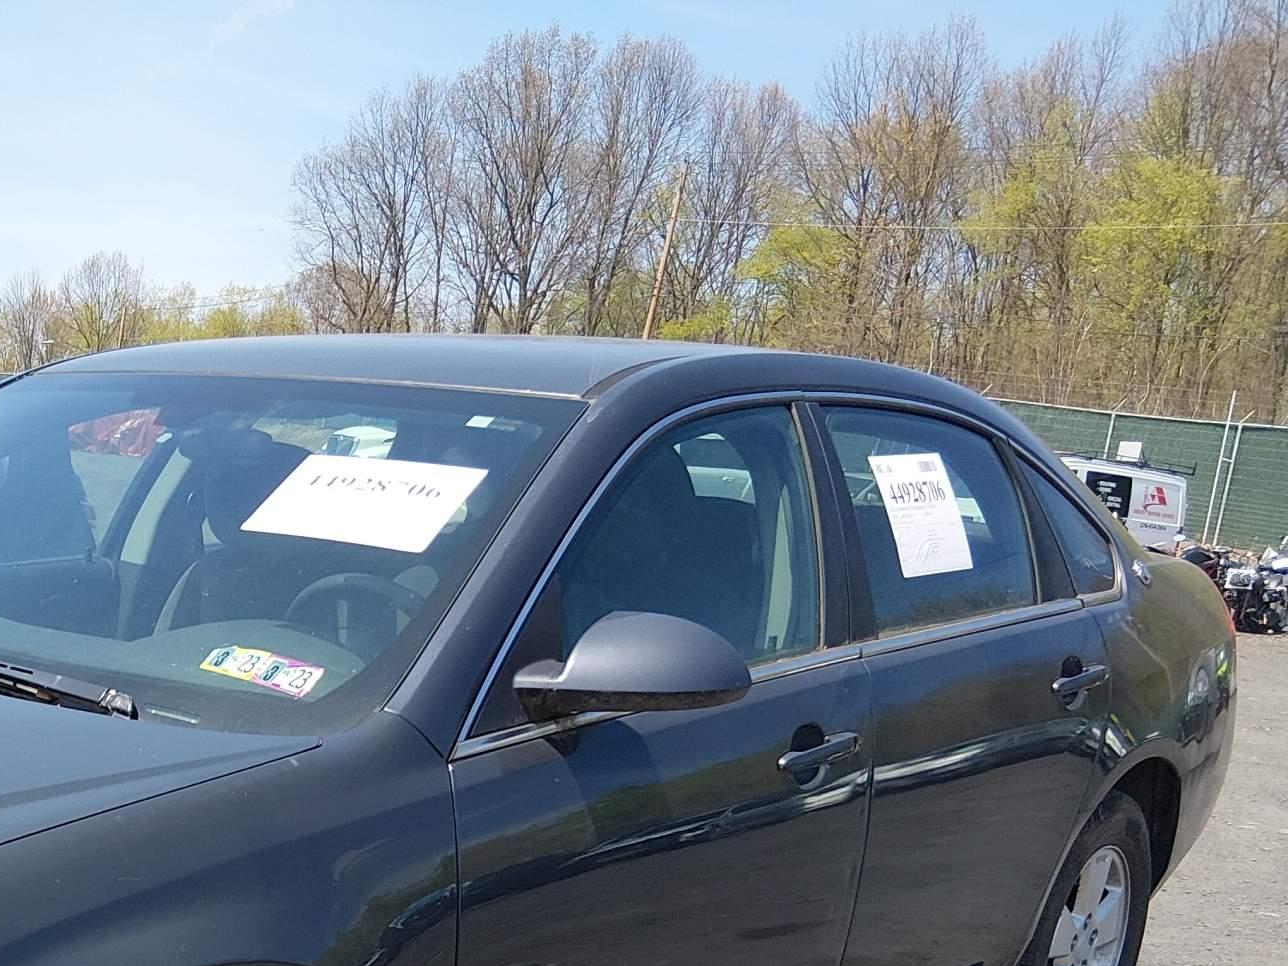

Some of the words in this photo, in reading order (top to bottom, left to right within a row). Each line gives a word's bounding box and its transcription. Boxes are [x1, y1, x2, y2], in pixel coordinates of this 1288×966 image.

[889, 479, 946, 505] 44928706
[237, 654, 261, 673] 23
[288, 669, 312, 689] 23
